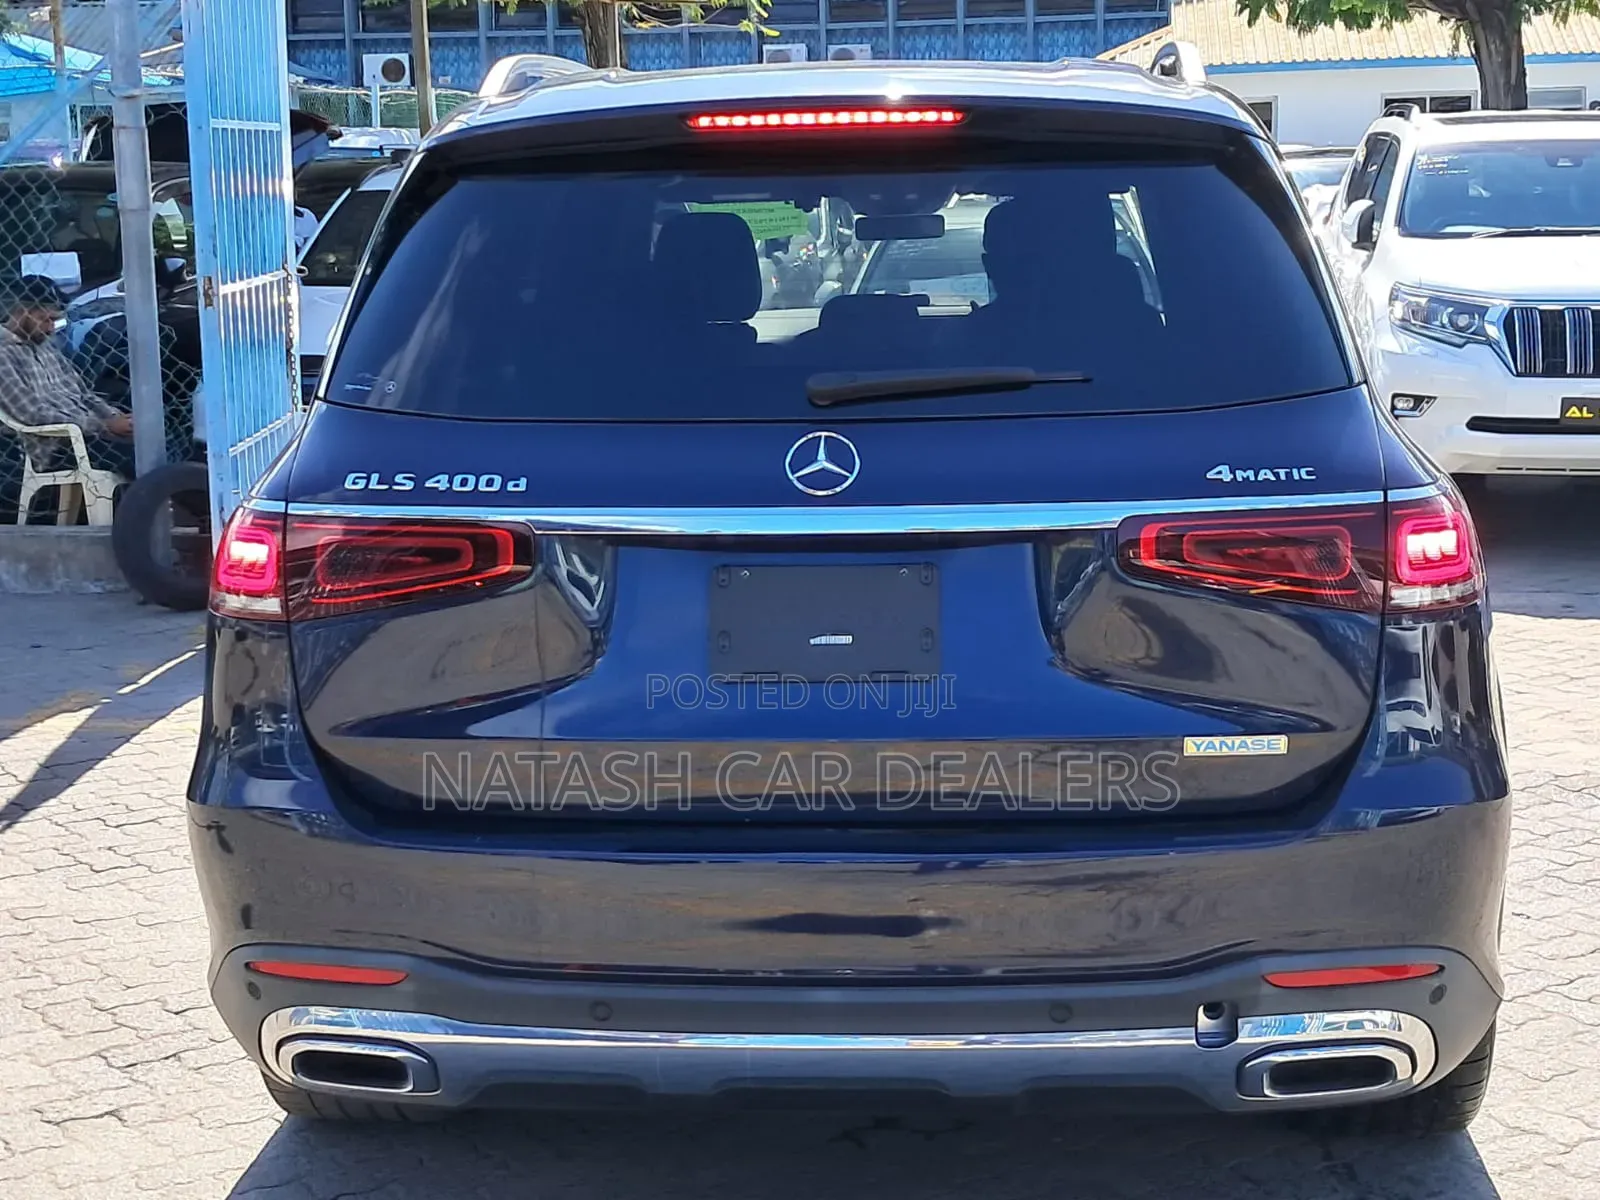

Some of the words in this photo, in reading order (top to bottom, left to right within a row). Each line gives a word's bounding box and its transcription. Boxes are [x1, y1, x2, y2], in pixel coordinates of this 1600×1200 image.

[1564, 405, 1595, 419] AL
[1206, 464, 1317, 482] 4MATIC
[344, 472, 417, 490] GLS
[424, 473, 528, 492] 400d
[1191, 738, 1282, 752] YANASE
